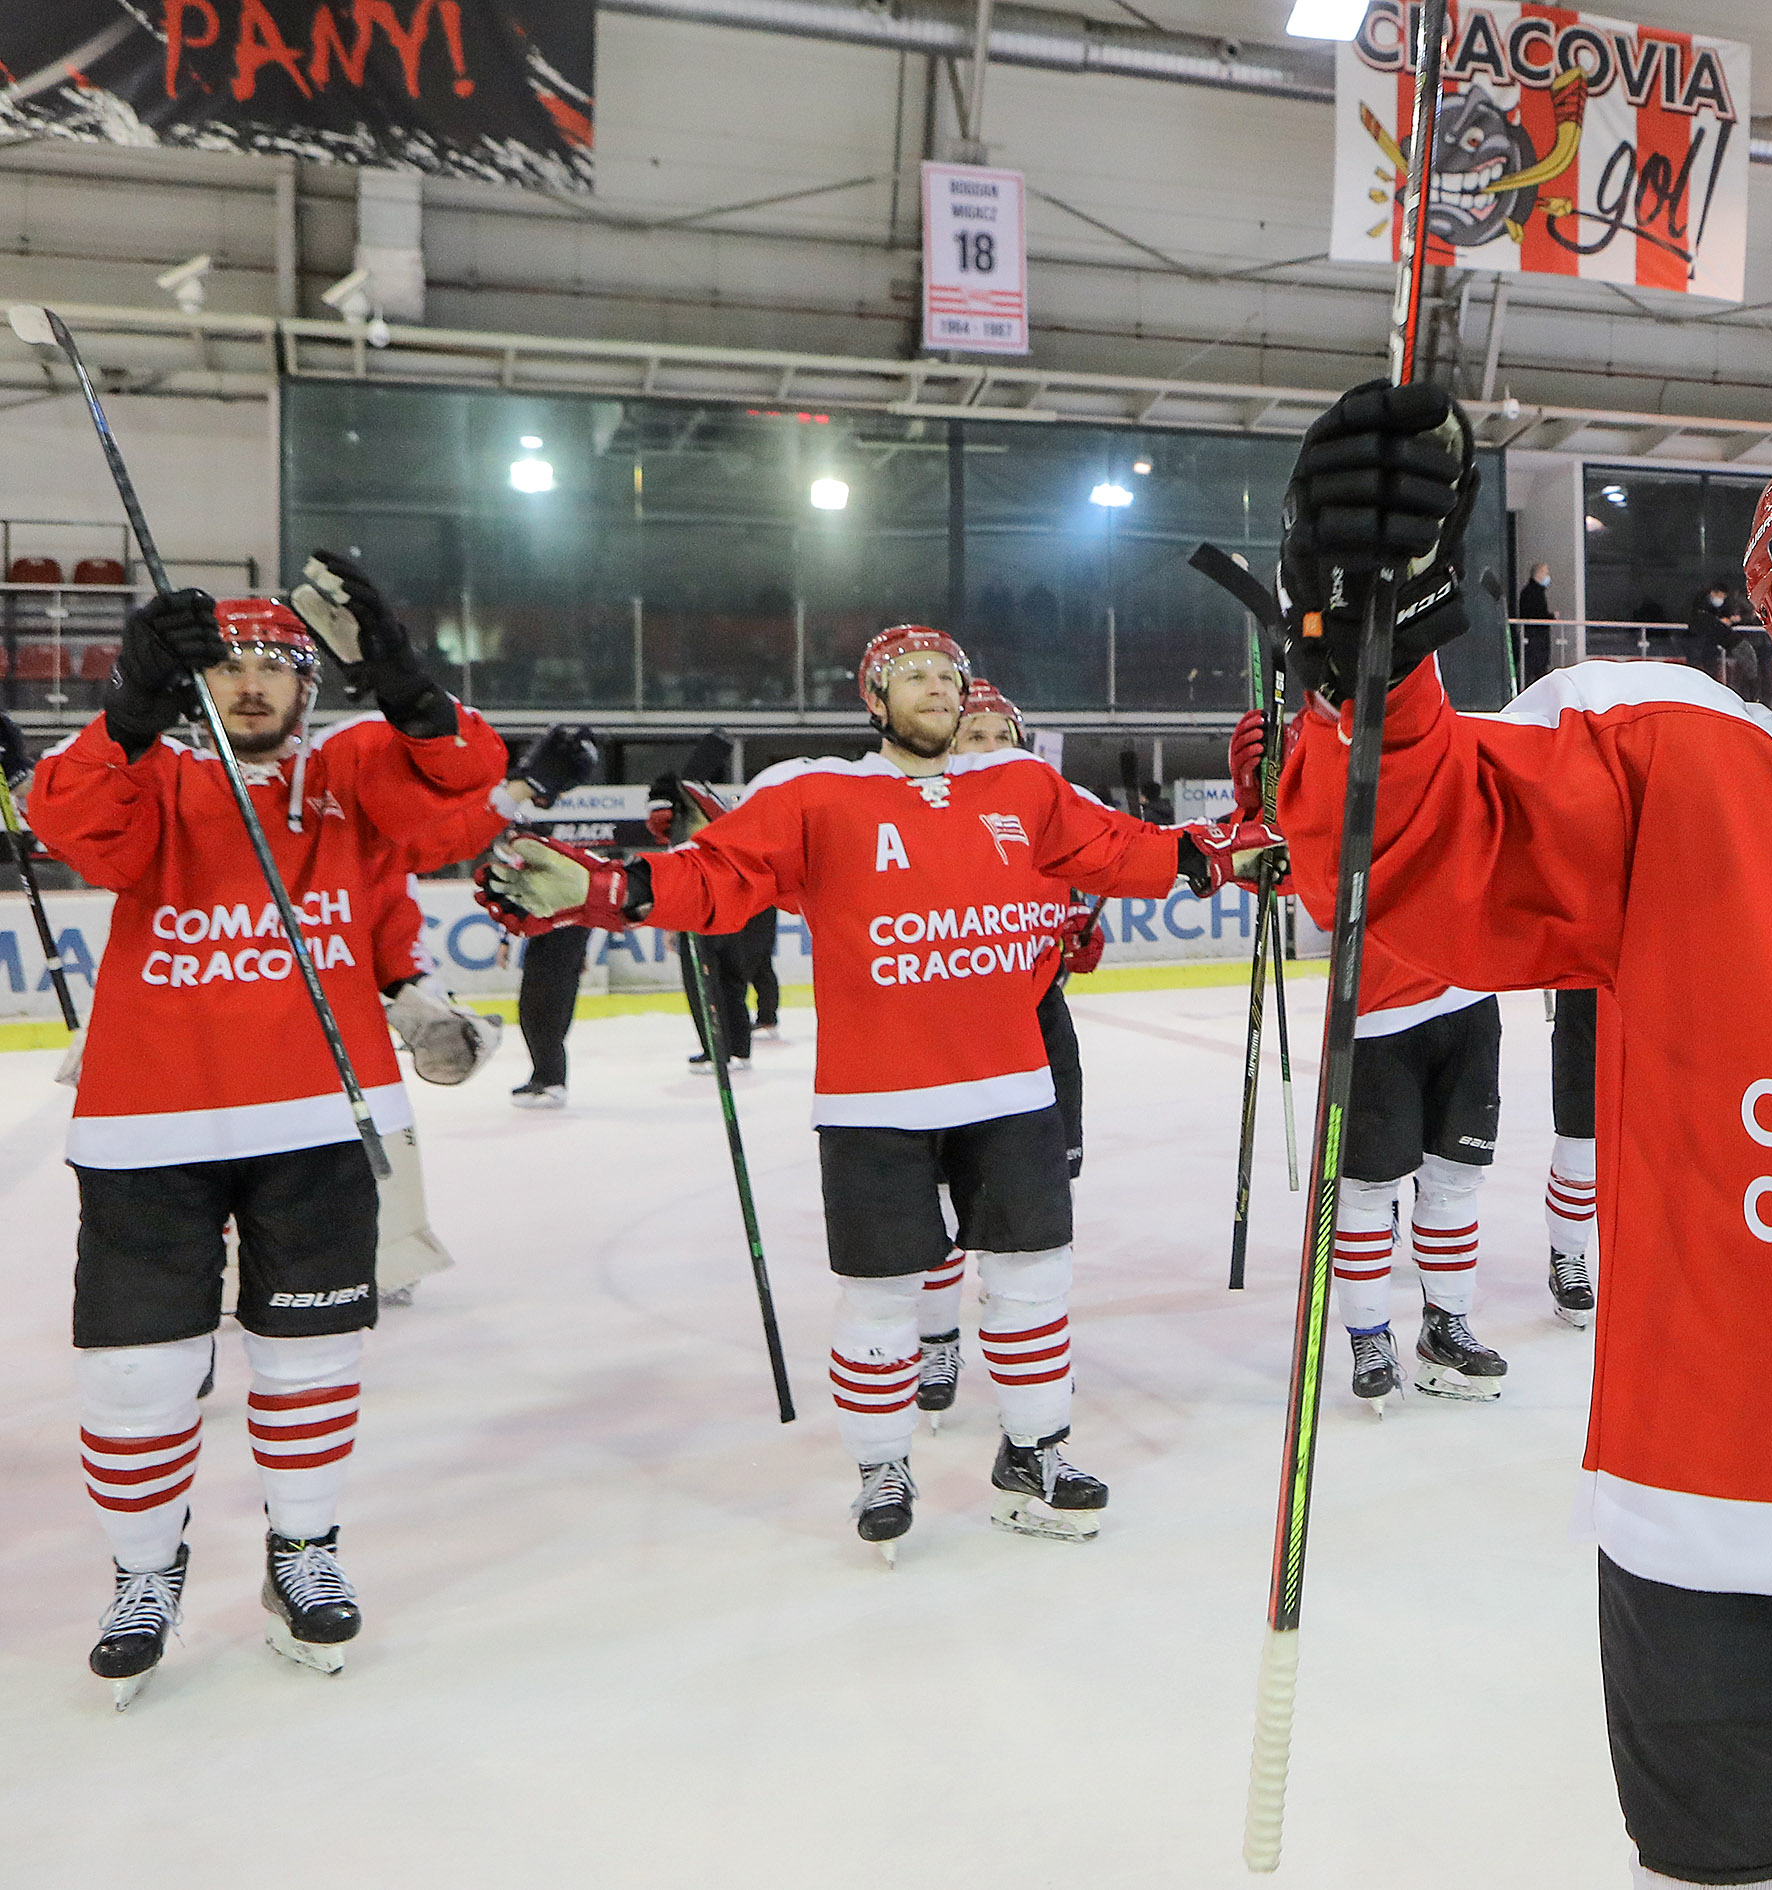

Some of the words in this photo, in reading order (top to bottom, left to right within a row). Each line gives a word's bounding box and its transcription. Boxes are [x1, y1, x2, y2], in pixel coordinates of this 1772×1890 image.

[160, 0, 475, 101] PANY!
[1354, 0, 1736, 122] CACOVIA
[953, 229, 996, 274] 18
[1396, 580, 1452, 626] CCM
[875, 822, 911, 872] A
[141, 934, 356, 988] CRACOIA
[1458, 1135, 1495, 1150] BAUE
[269, 1283, 370, 1308] BAUER
